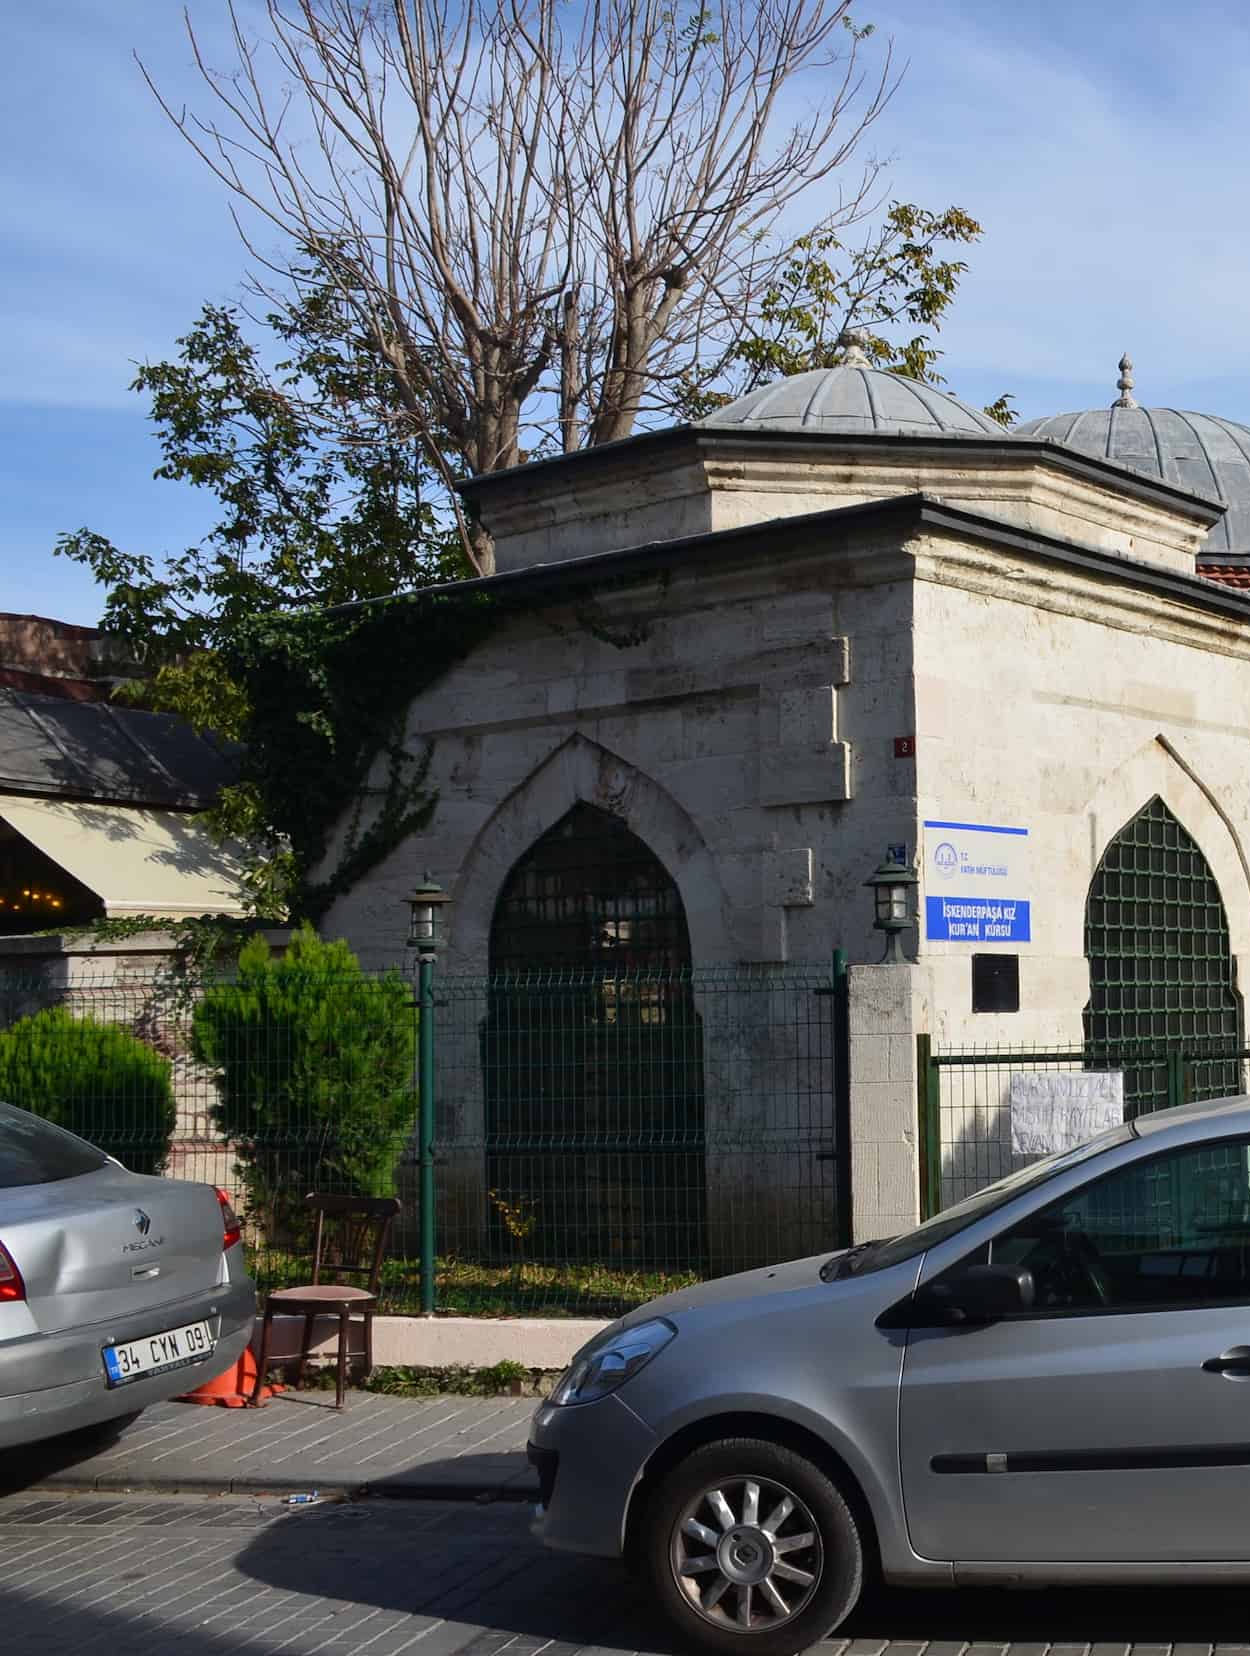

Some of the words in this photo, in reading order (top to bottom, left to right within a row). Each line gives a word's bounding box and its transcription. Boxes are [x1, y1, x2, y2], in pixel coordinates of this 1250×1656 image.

[1003, 907, 1017, 920] KIZ
[118, 1349, 141, 1373] 34
[150, 1333, 180, 1363] CYN
[185, 1327, 205, 1351] 09
